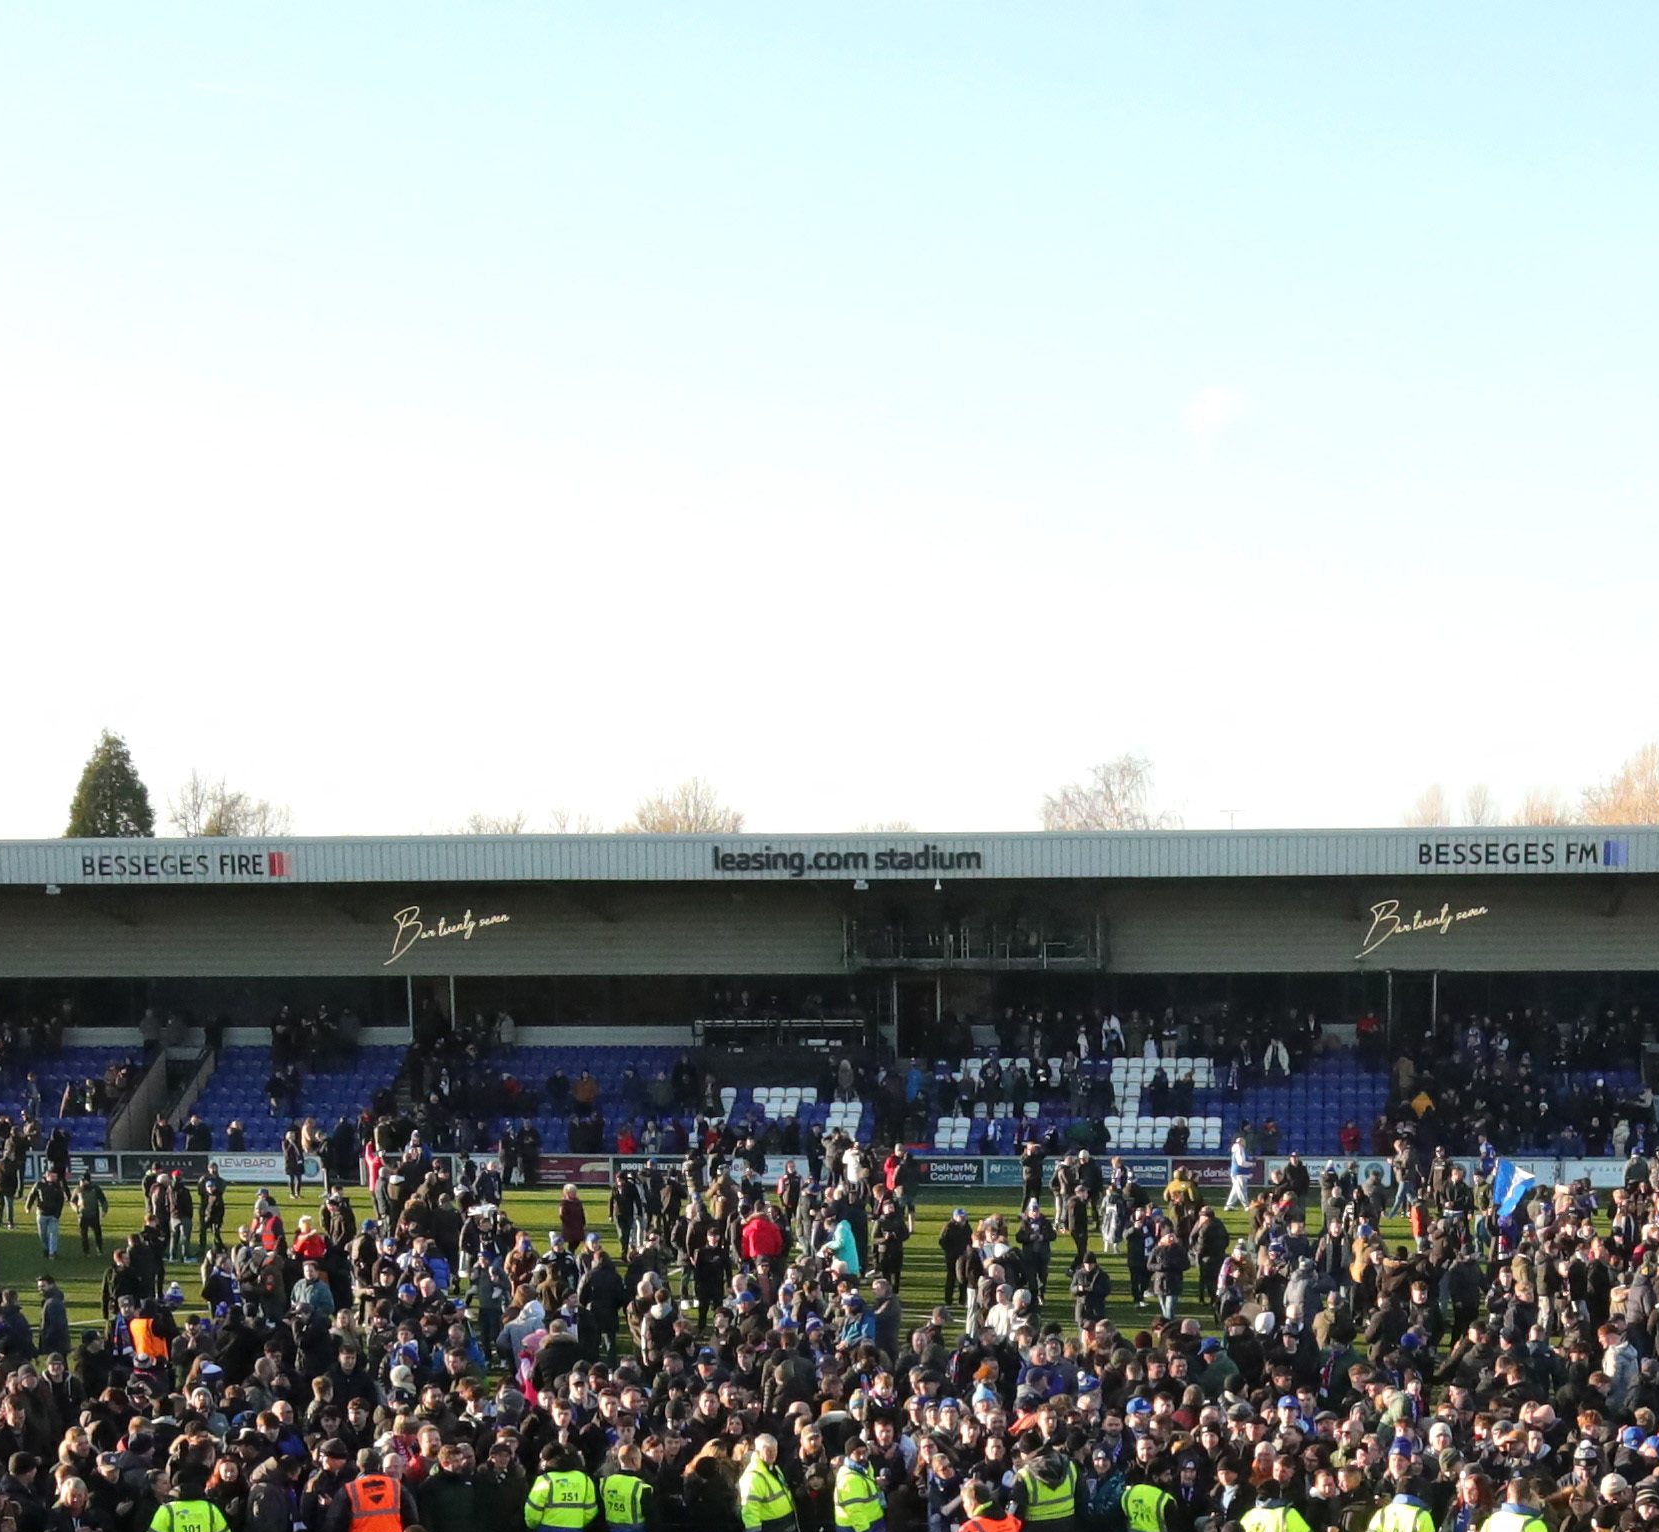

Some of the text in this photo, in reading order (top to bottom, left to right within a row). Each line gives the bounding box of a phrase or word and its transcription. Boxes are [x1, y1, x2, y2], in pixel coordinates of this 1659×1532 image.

[82, 854, 264, 876] BESSEGES FIRE
[713, 844, 981, 877] leasing.com stadium
[1419, 843, 1598, 865] BESSEGES FM
[383, 905, 436, 966] Bar
[438, 908, 476, 940] twenty
[1354, 900, 1412, 958] Bar
[1412, 902, 1454, 934] twenty
[220, 1158, 276, 1168] LEWBARD
[930, 1162, 978, 1173] DeliverMy
[930, 1172, 978, 1182] Container
[561, 1492, 579, 1502] 351
